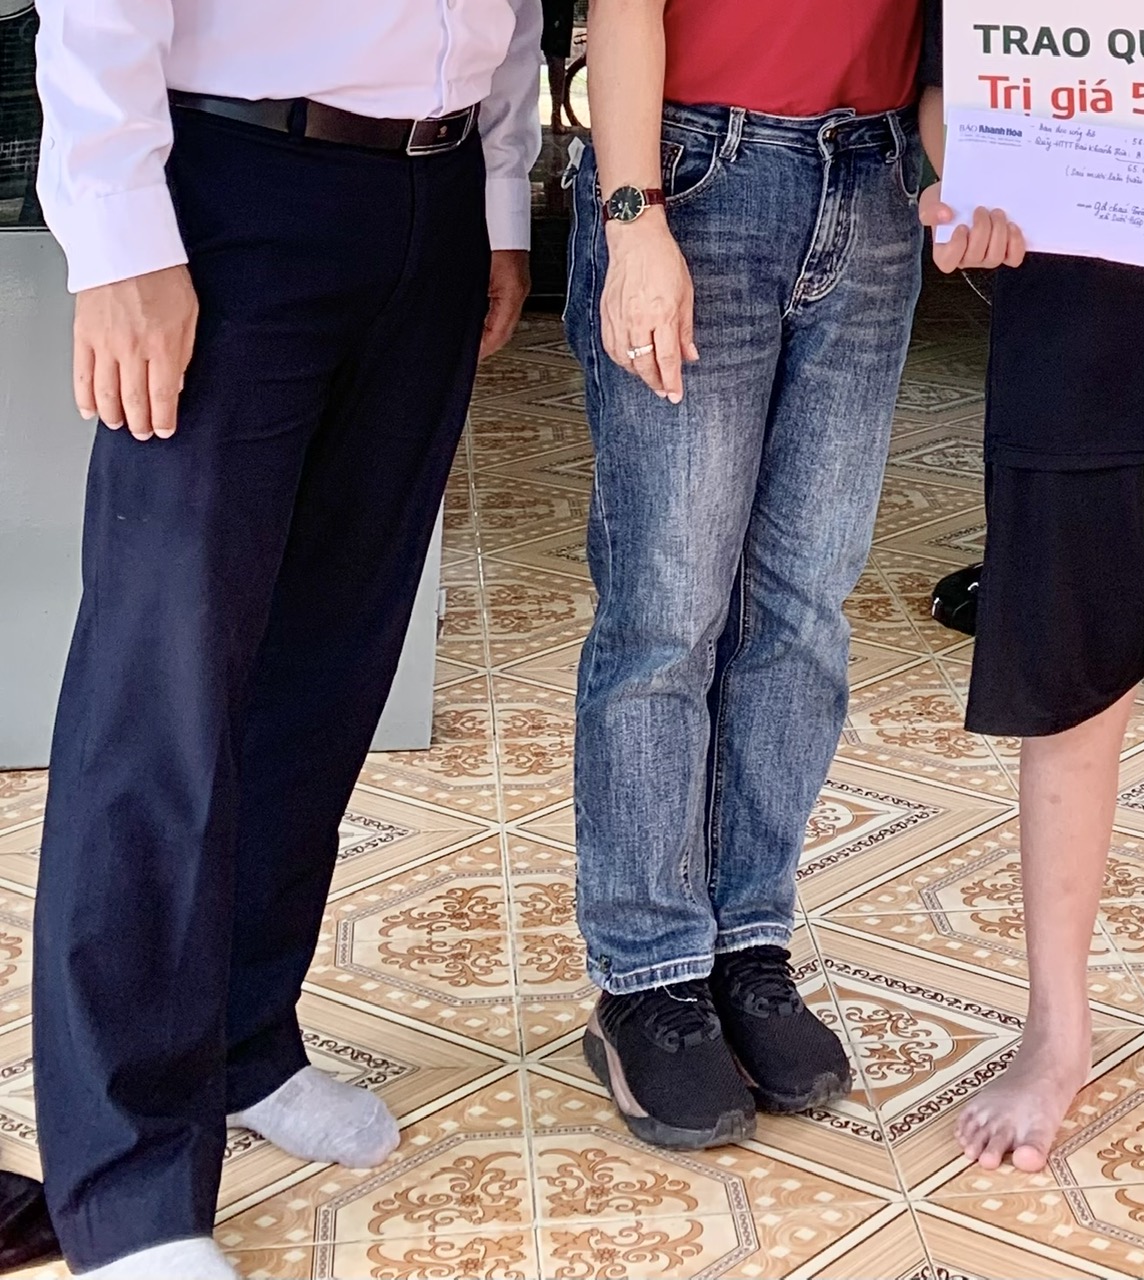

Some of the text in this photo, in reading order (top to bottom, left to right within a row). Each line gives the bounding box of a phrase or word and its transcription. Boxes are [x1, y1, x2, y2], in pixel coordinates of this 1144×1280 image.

[973, 23, 1092, 59] TRAO
[978, 74, 1032, 117] Trị
[1050, 78, 1113, 120] giá
